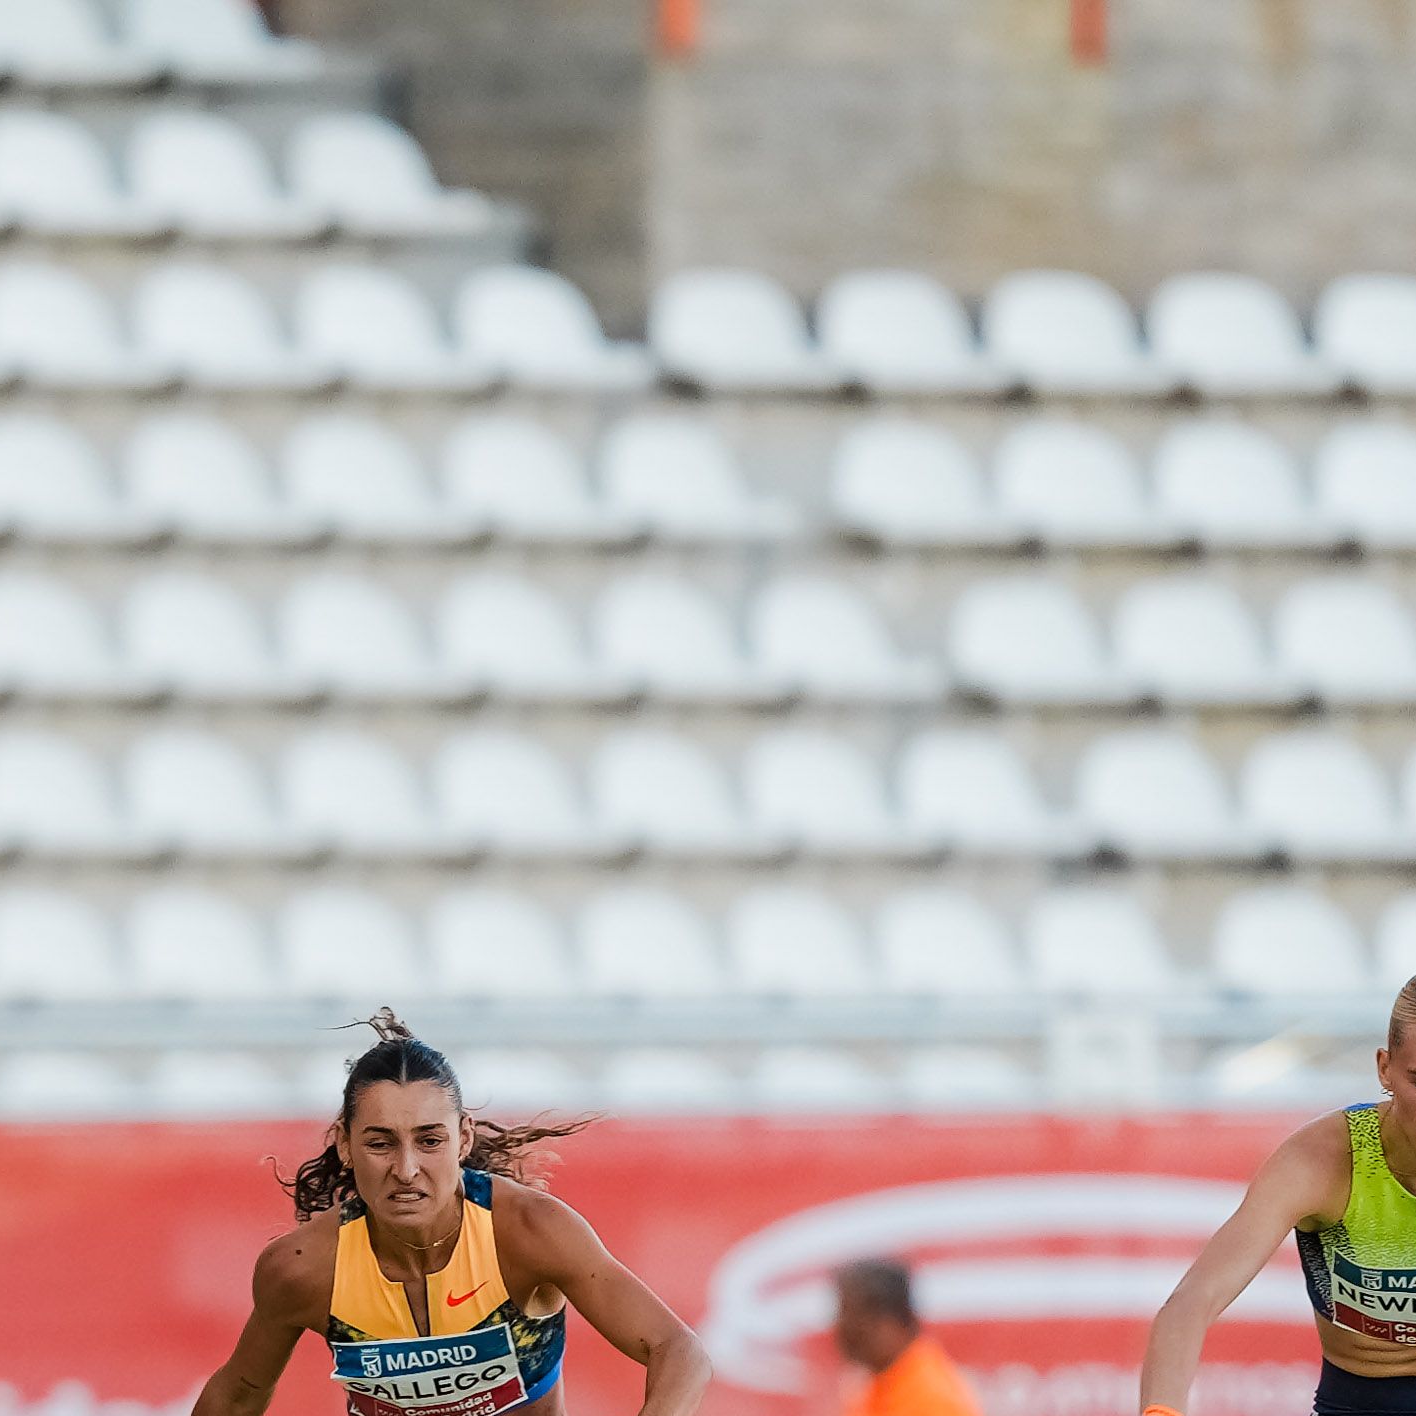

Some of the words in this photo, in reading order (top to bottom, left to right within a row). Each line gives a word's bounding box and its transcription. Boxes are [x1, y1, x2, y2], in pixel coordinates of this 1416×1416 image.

[1395, 1334, 1416, 1343] de
[386, 1345, 477, 1372] MADRID
[347, 1364, 506, 1400] GALLEGO
[405, 1392, 493, 1416] Comunidad
